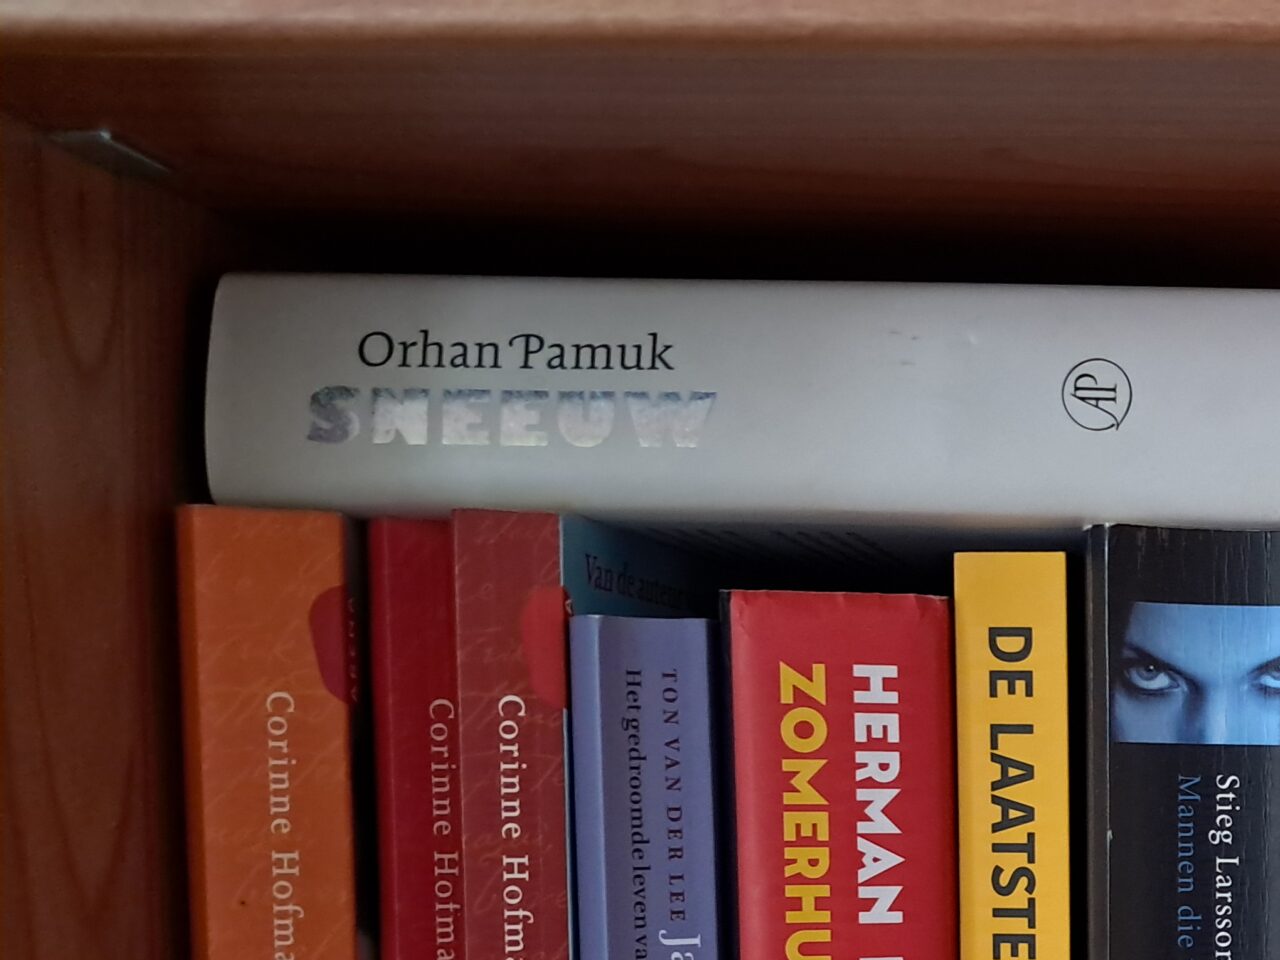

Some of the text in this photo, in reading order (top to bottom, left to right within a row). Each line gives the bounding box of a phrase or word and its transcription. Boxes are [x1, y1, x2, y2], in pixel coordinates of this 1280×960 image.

[358, 330, 676, 371] Orhan Pamuk
[307, 384, 718, 448] SNEEUW
[625, 669, 642, 711] Het
[988, 626, 1034, 699] DE
[661, 668, 680, 725] TON
[265, 690, 297, 835] Corinne
[429, 698, 457, 836] Corinne
[498, 694, 527, 839] Corinne
[621, 717, 650, 861] gedroomde
[664, 737, 682, 792] VAN
[851, 663, 906, 925] HERMAN
[666, 806, 684, 860] DER
[1177, 775, 1202, 894] Mannen
[1207, 773, 1241, 846] Stieg
[631, 865, 652, 931] leven
[669, 873, 686, 921] LEE
[1177, 904, 1203, 949] die
